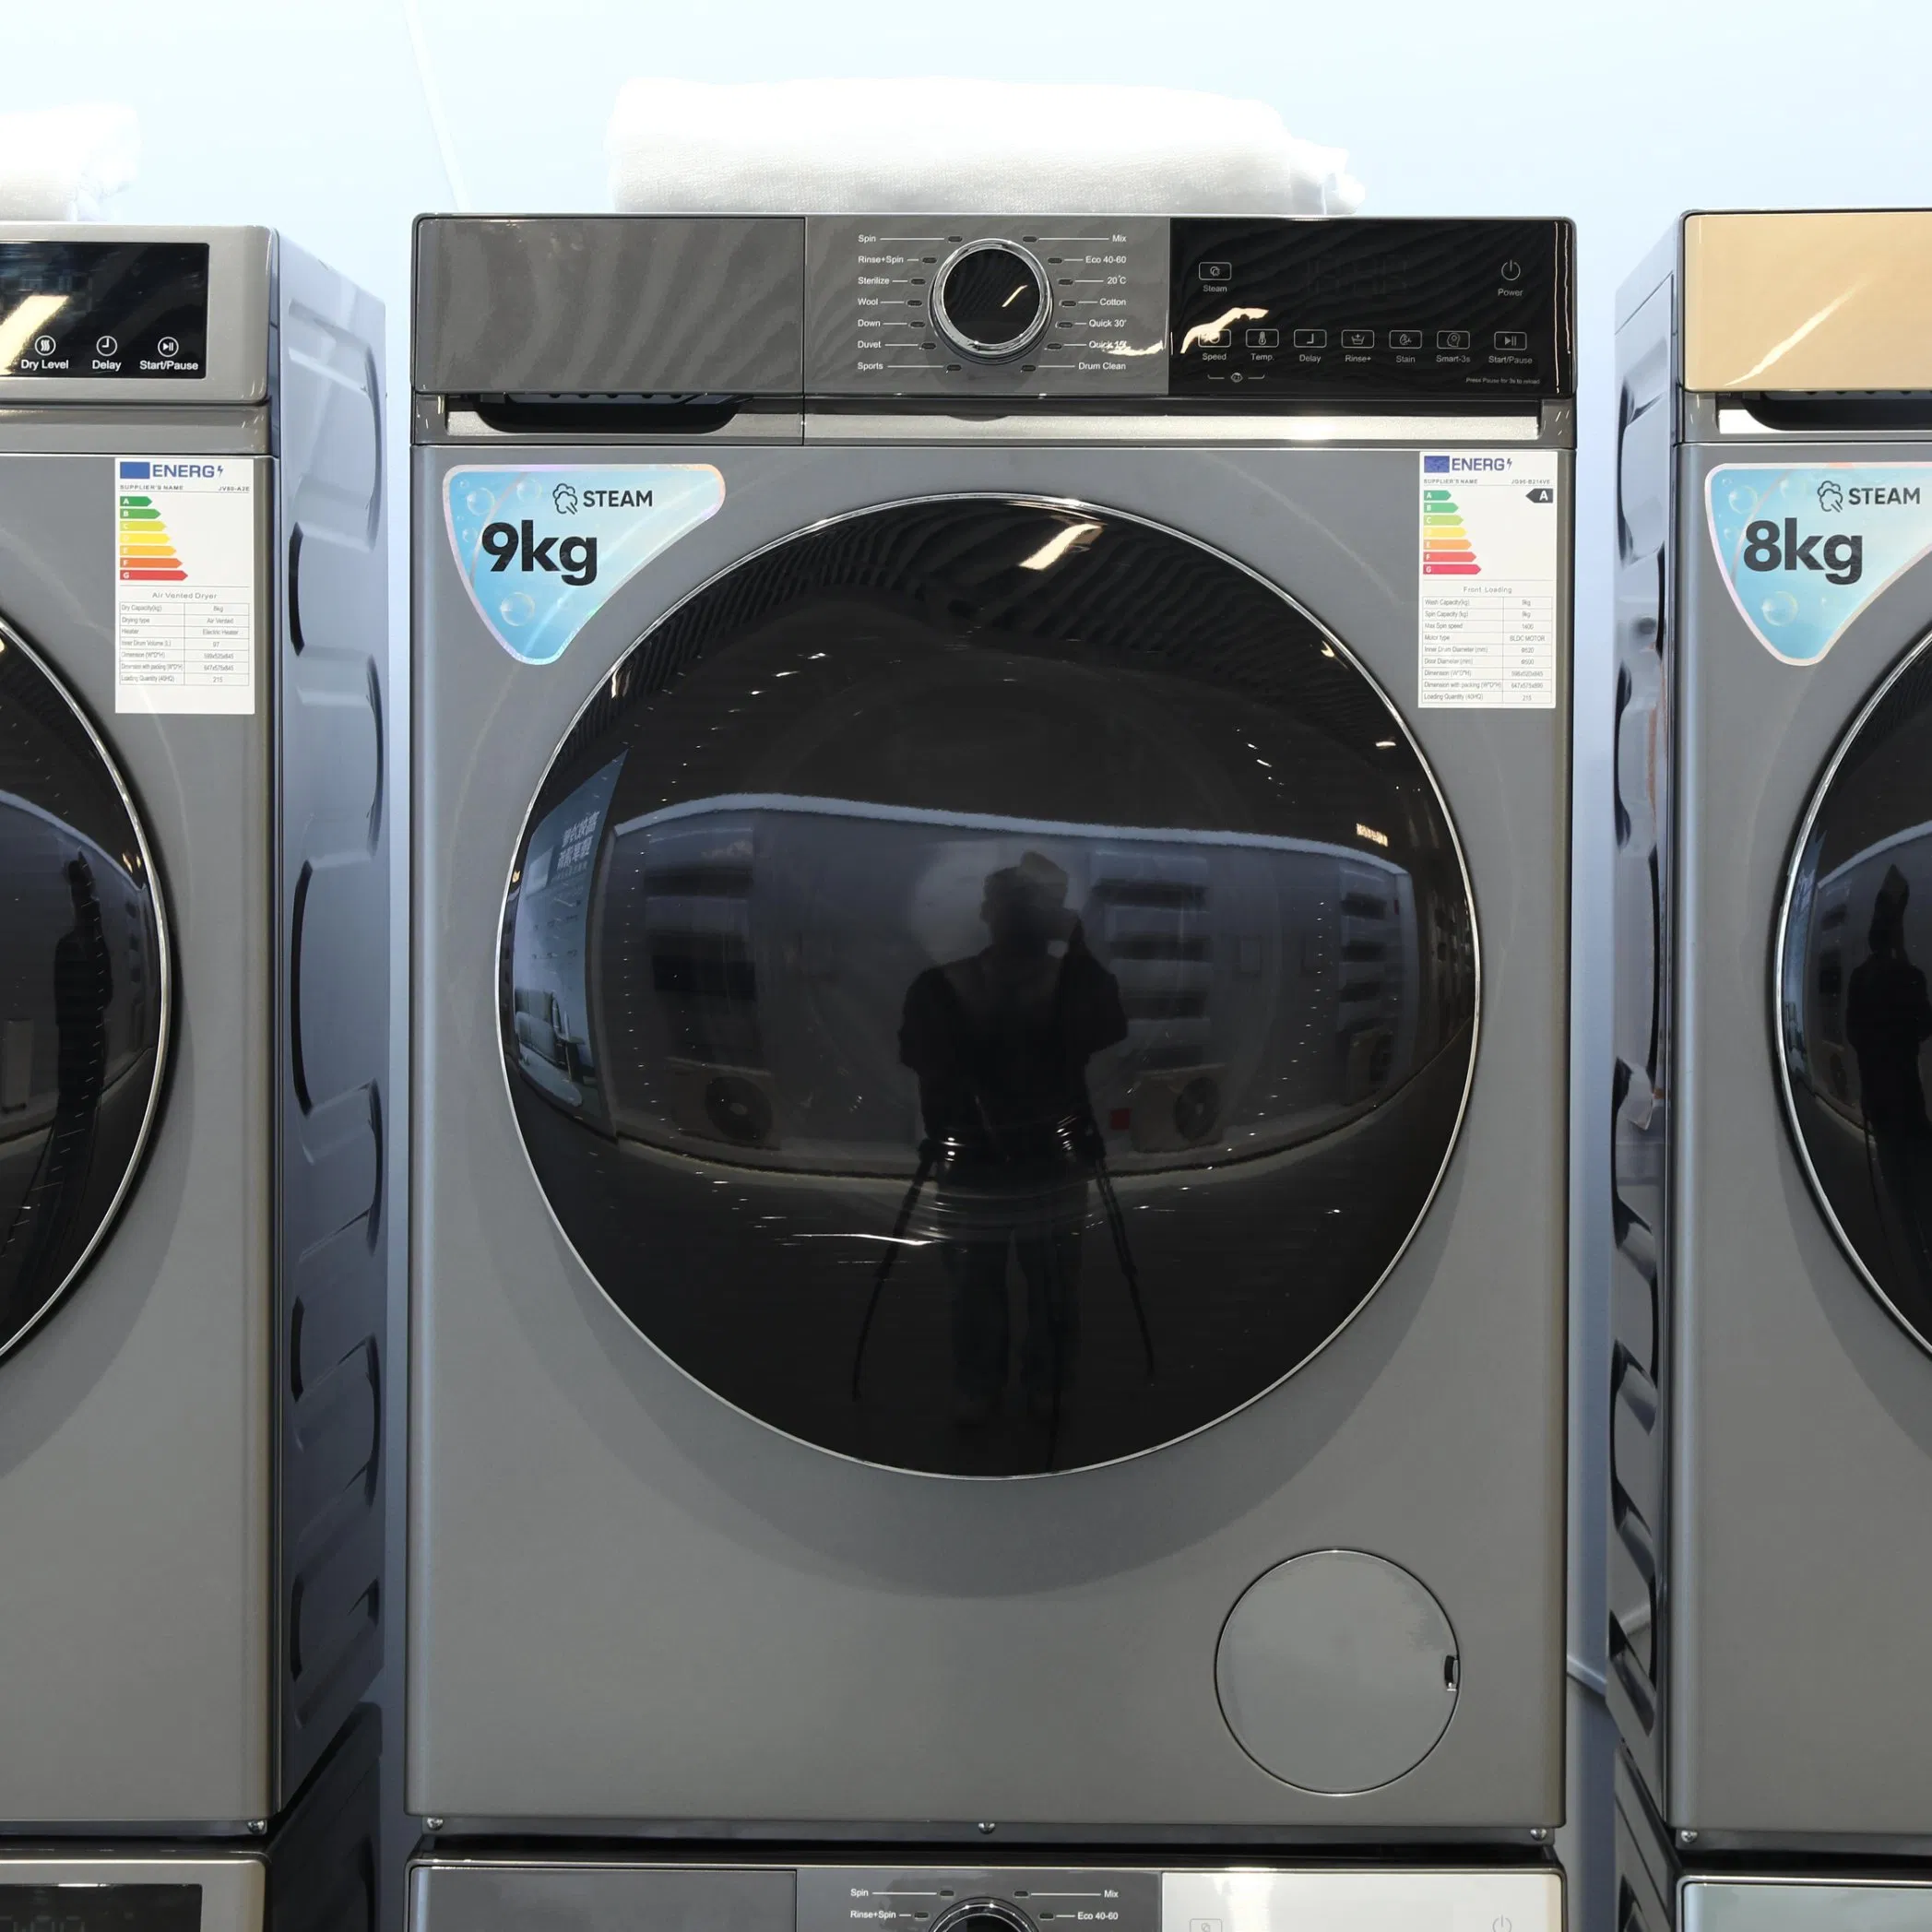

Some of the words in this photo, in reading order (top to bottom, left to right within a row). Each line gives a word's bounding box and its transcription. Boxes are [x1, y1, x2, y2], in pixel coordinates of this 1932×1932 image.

[858, 256, 904, 265] Rinse+Spin
[858, 277, 890, 285] Sterilize
[1203, 284, 1227, 292] Steam
[1498, 289, 1523, 297] Power
[858, 298, 878, 306] Wool
[1099, 298, 1127, 306] Cotton
[1089, 319, 1112, 327] Quick
[858, 340, 881, 349] Duvet
[1202, 353, 1227, 362] Speed
[1250, 353, 1274, 362] Temp.
[1299, 354, 1322, 363] Delay
[1345, 354, 1371, 362] Rinse+
[1396, 355, 1416, 363] Stain
[1436, 355, 1470, 363] Smart-3s
[1488, 355, 1532, 364] Start/Pause
[21, 360, 40, 370] Dry
[41, 360, 68, 369] Level
[92, 361, 121, 371] Delay
[139, 361, 198, 370] Start/Pause
[858, 362, 883, 371] Sports
[1078, 362, 1100, 370] Drum
[1103, 362, 1126, 370] Clean
[1452, 458, 1505, 471] ENERG
[153, 465, 214, 478] ENERG
[583, 490, 653, 507] STEAM
[1539, 491, 1548, 501] A
[1849, 488, 1920, 504] STEAM
[481, 520, 598, 586] 9kg
[1744, 517, 1863, 585] 8kg
[850, 1889, 869, 1898] Spin
[850, 1910, 896, 1920] Rinse+Spin
[1077, 1912, 1093, 1920] Eco
[1095, 1912, 1119, 1920] 40-60
